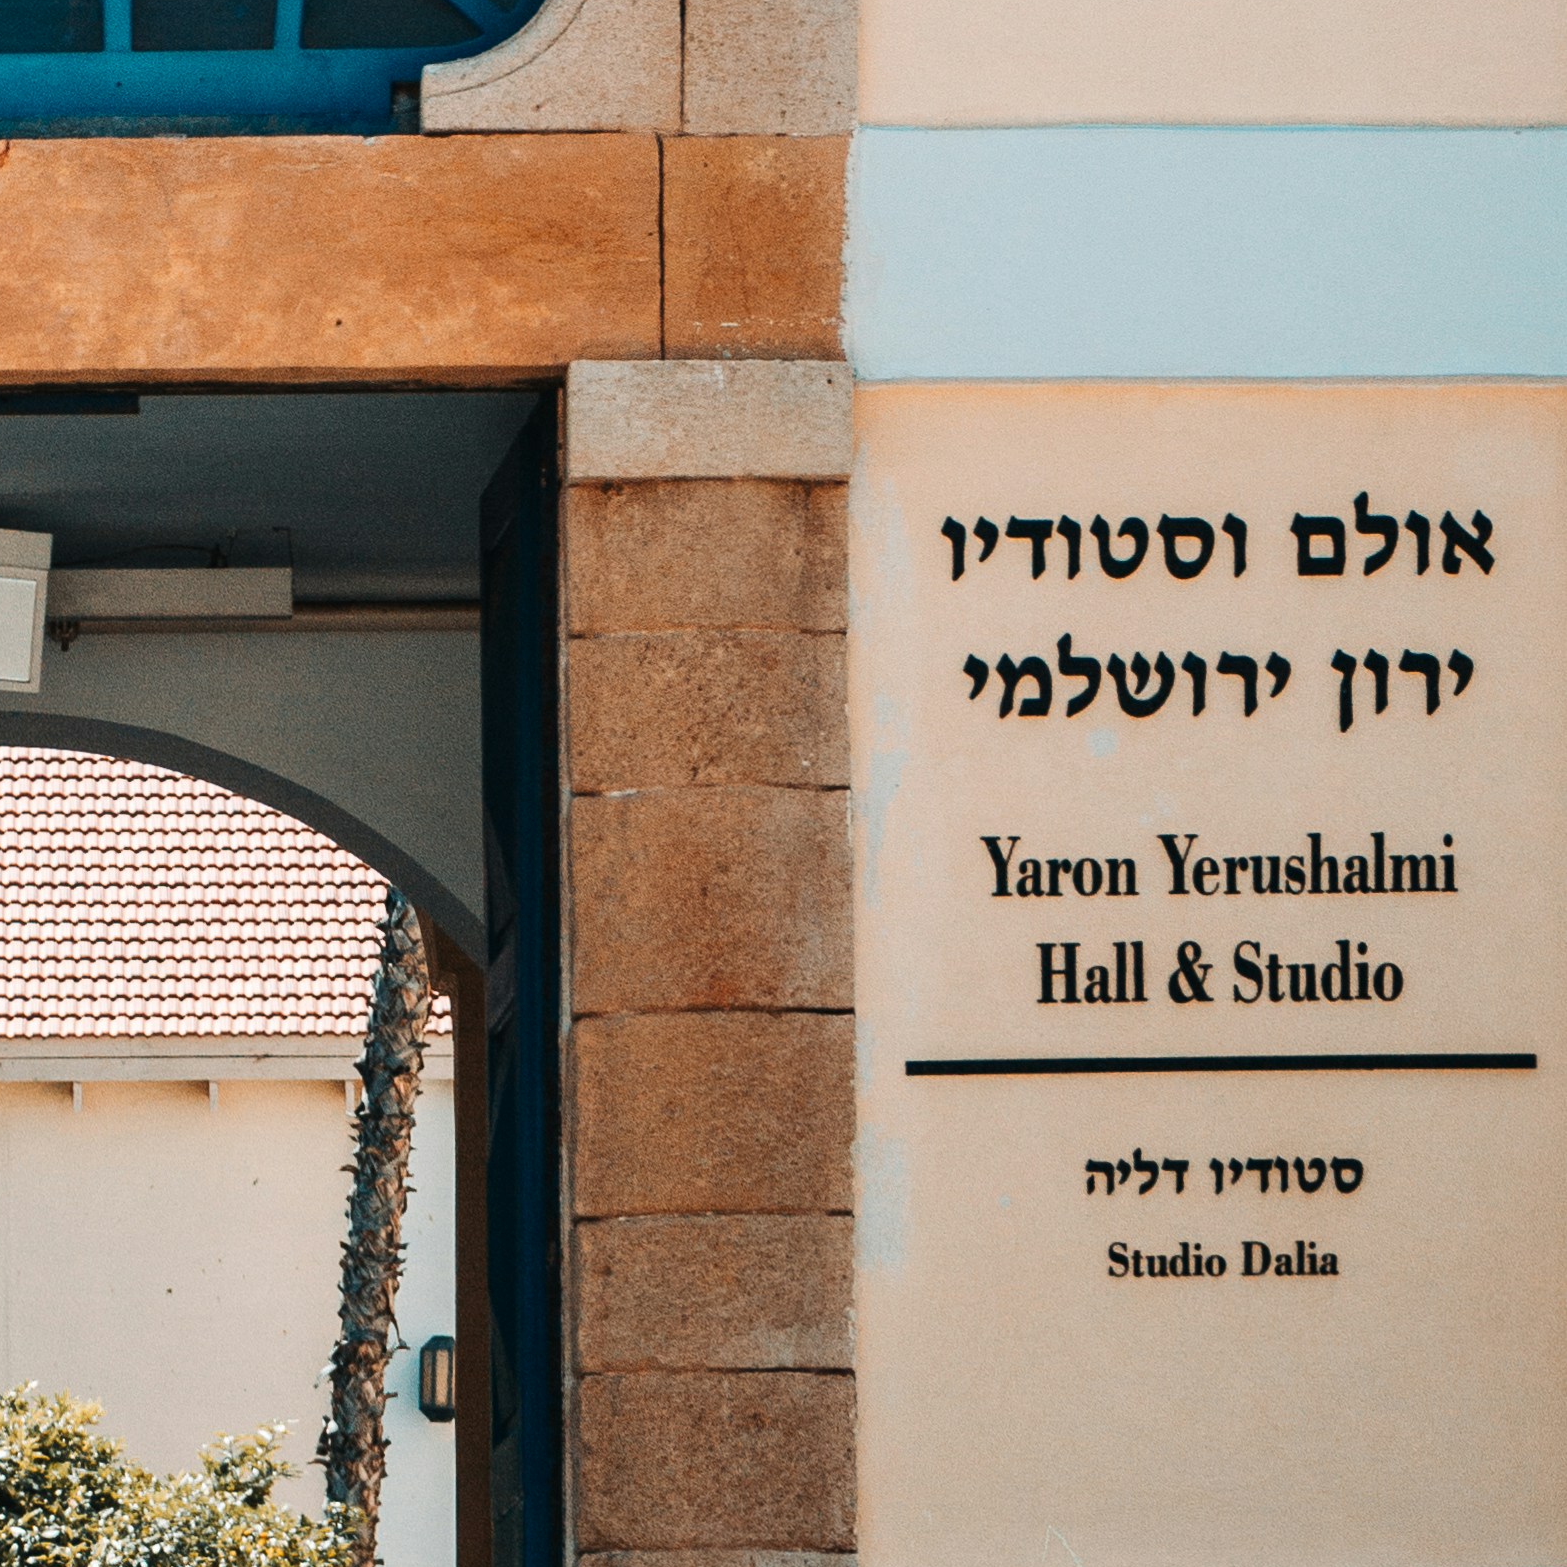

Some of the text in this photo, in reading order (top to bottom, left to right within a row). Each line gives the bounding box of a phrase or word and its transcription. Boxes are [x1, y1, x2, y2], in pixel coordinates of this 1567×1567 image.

[940, 490, 1496, 582] אולם וסטודיו
[962, 632, 1475, 734] ירון ירושלמי
[979, 831, 1459, 898] Yaron Yerushalmi
[1035, 938, 1405, 1005] Hall & Studio
[1084, 1147, 1365, 1196] סטודיו דליה
[1107, 1239, 1340, 1279] Studio Dalia
